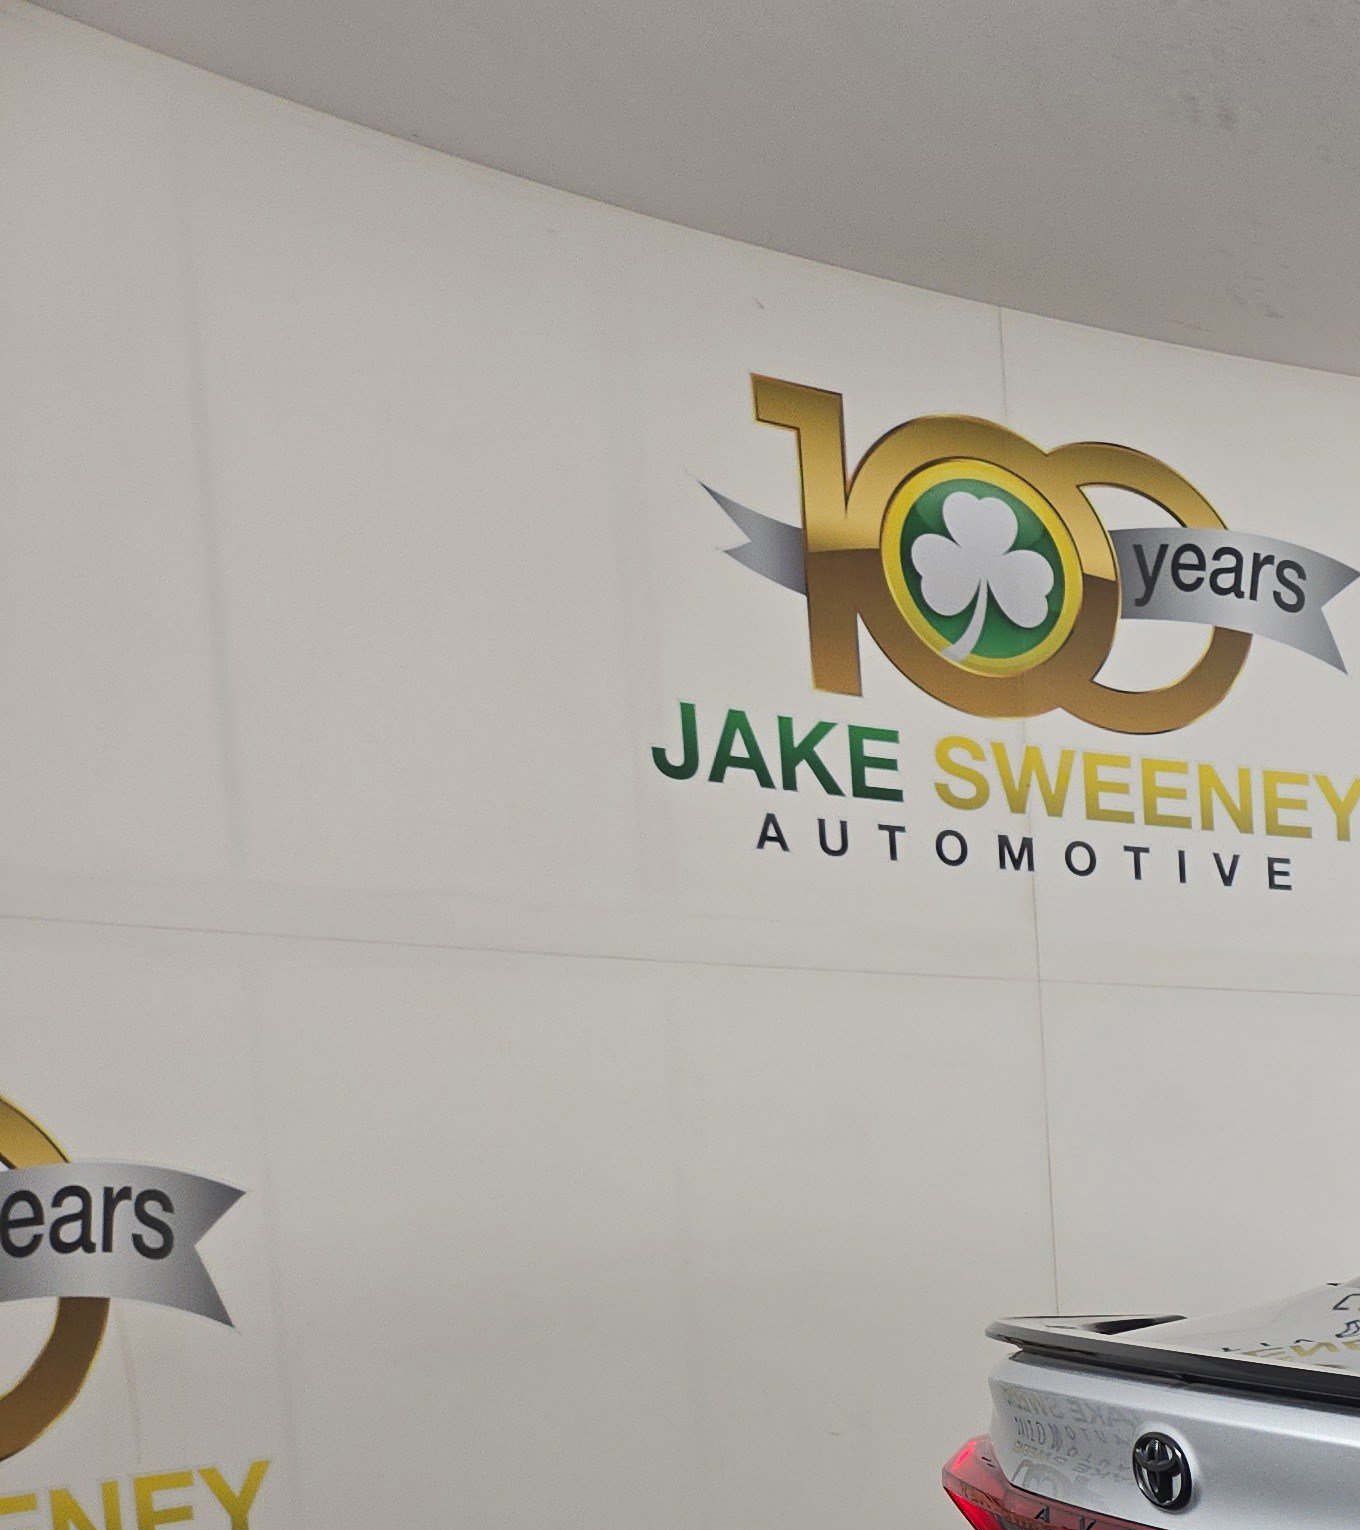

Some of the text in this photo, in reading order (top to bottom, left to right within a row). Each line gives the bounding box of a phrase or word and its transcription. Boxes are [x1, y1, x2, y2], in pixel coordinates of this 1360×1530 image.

[1133, 541, 1309, 614] years
[650, 701, 905, 803] JAKE
[756, 812, 1294, 892] AUTOMOTIVE
